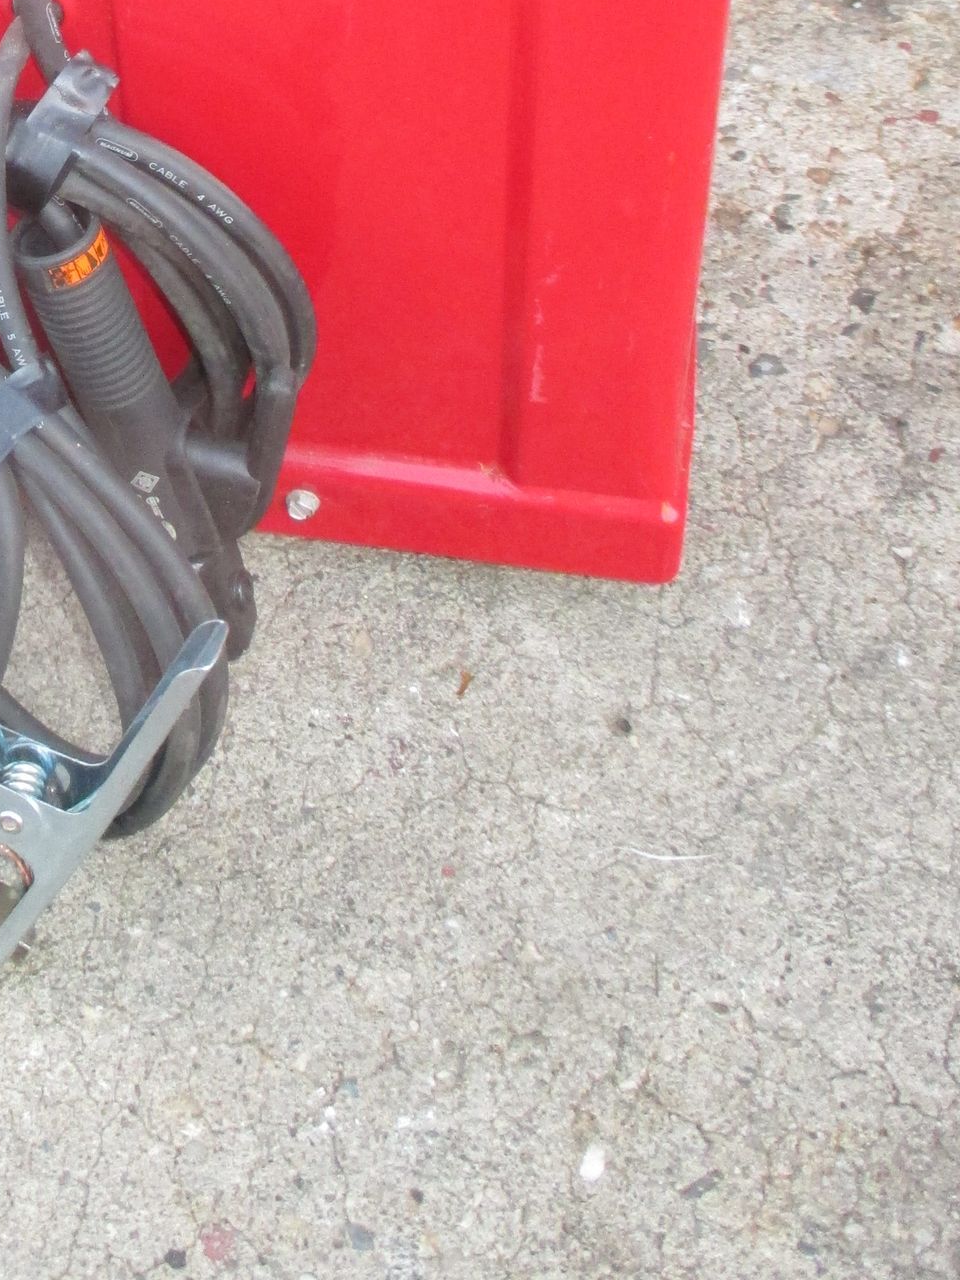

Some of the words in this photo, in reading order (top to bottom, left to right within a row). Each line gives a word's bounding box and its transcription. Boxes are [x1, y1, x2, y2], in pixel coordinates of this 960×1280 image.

[149, 162, 188, 190] CABLE
[197, 194, 206, 202] 4
[207, 204, 234, 225] AWG
[7, 333, 15, 341] 5
